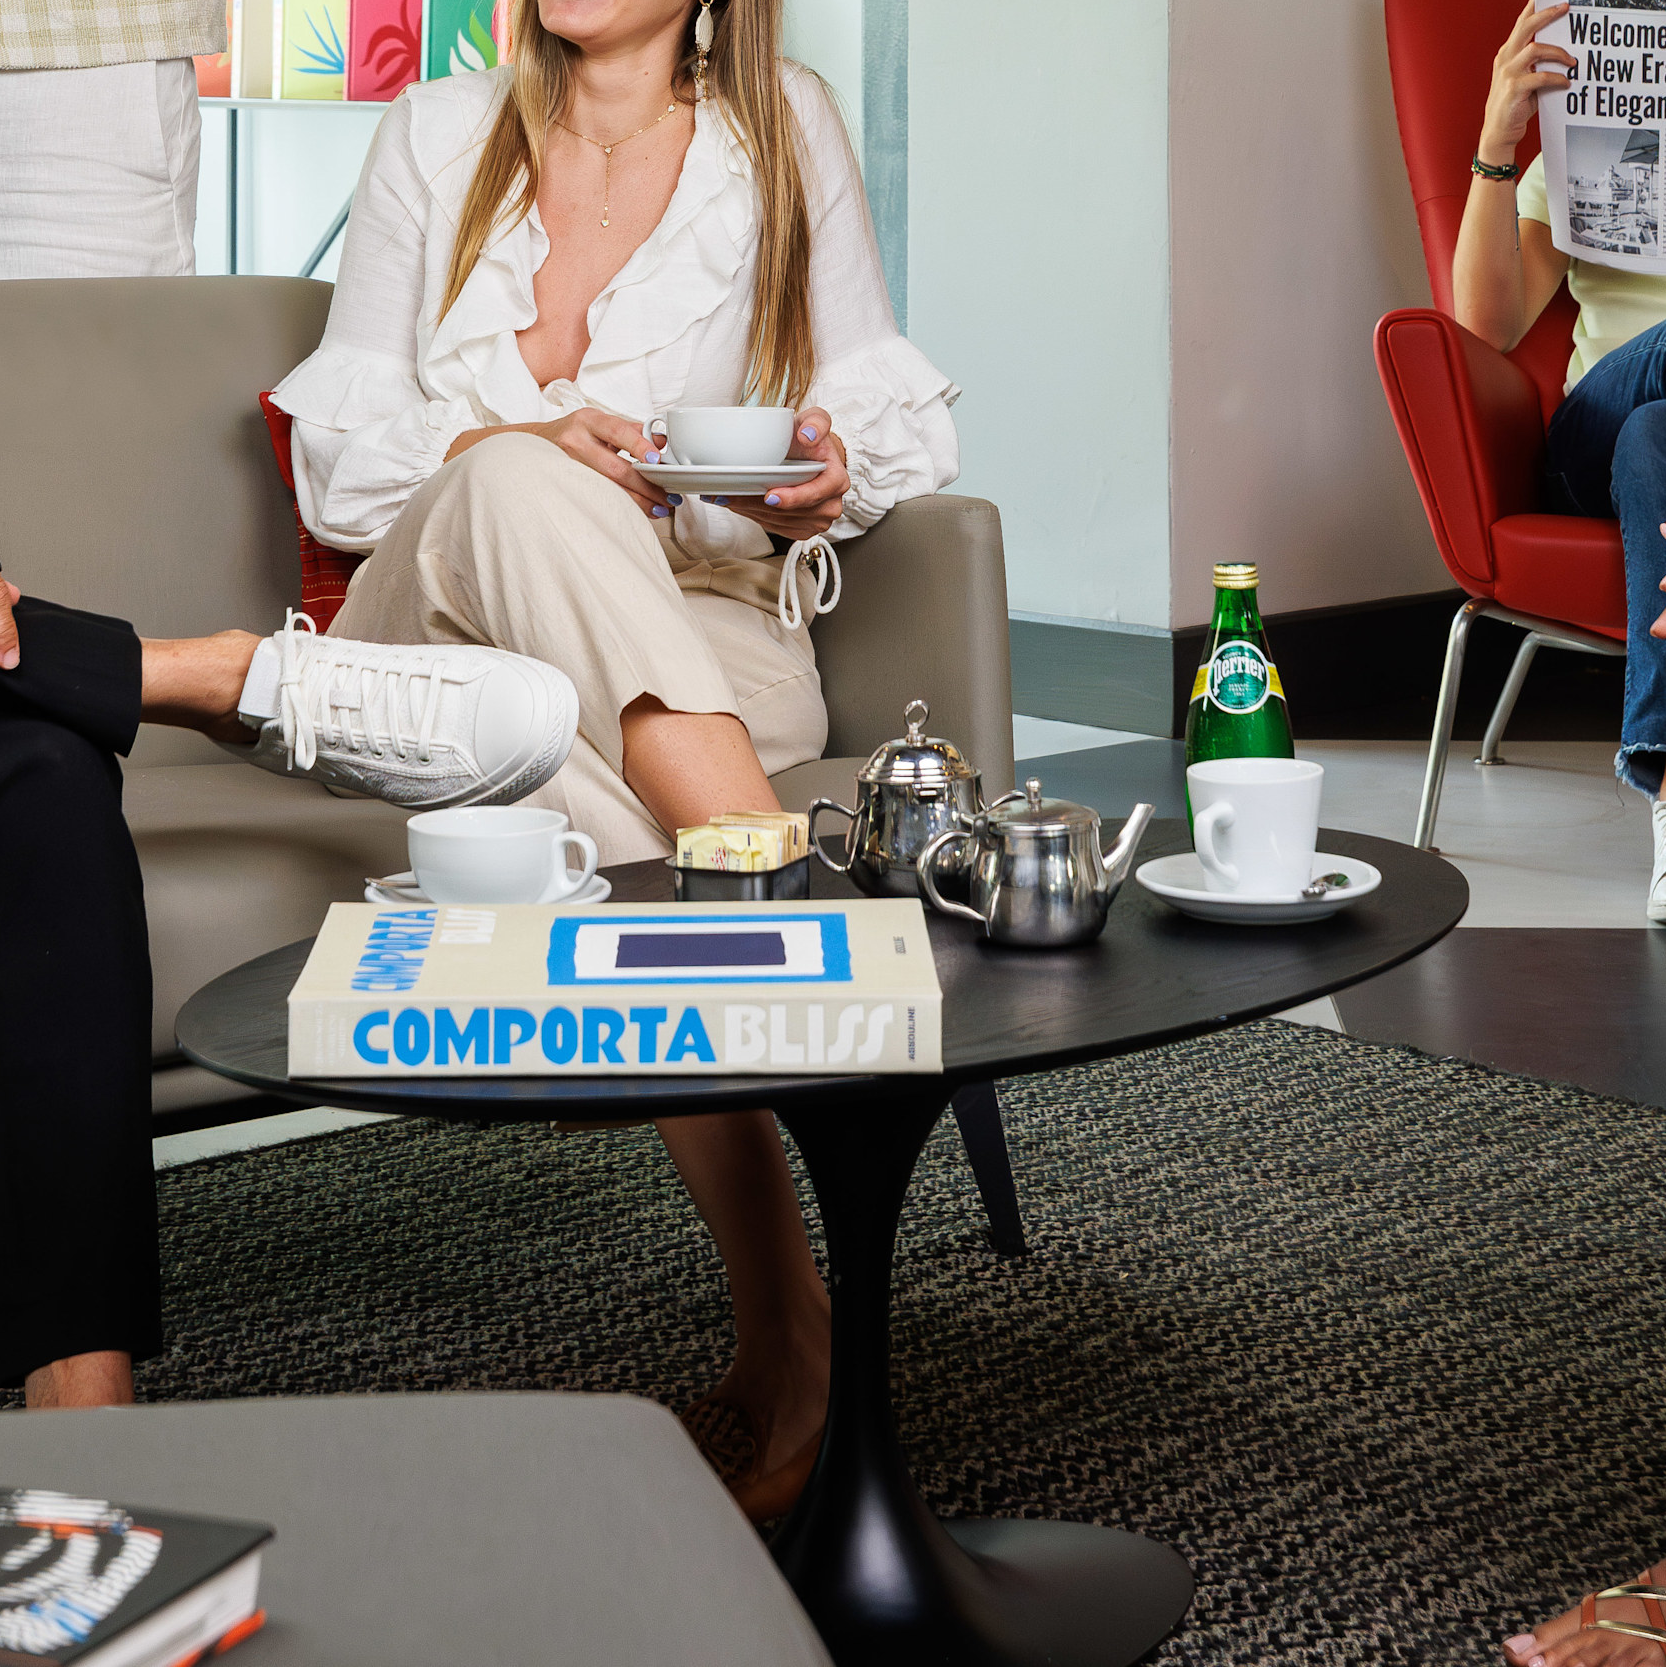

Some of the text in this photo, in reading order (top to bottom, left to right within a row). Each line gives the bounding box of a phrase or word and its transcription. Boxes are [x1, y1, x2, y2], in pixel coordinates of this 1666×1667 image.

[1566, 56, 1580, 83] a
[1586, 51, 1634, 85] New
[1566, 85, 1589, 116] of
[1213, 652, 1265, 696] Perrier
[350, 908, 439, 992] COMPORTA
[353, 1005, 716, 1067] COMPORTA
[724, 1003, 894, 1067] BLISS
[907, 1006, 916, 1063] ASSOULINE
